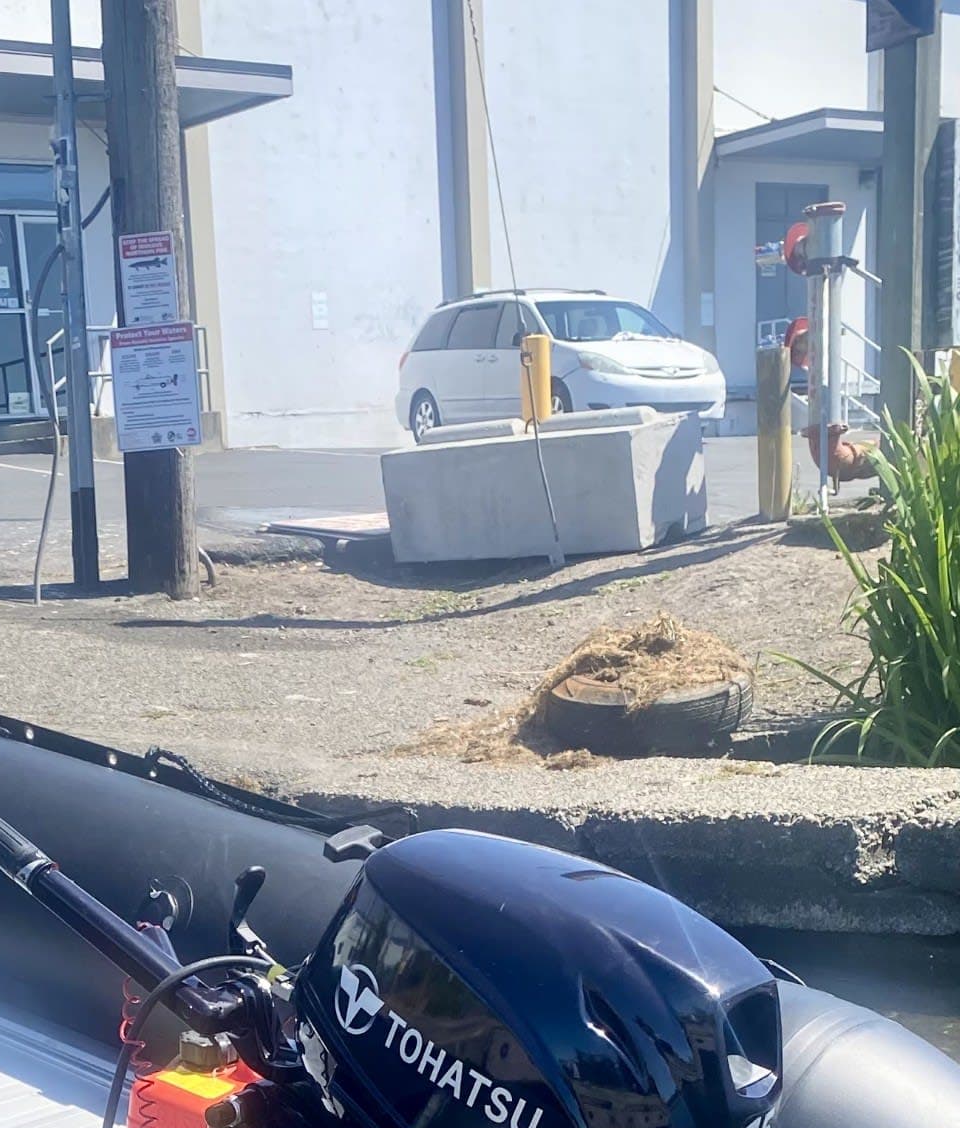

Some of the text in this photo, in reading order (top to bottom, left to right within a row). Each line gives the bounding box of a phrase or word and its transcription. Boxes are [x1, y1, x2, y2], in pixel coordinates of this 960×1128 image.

[116, 326, 187, 340] Protect Your Waters
